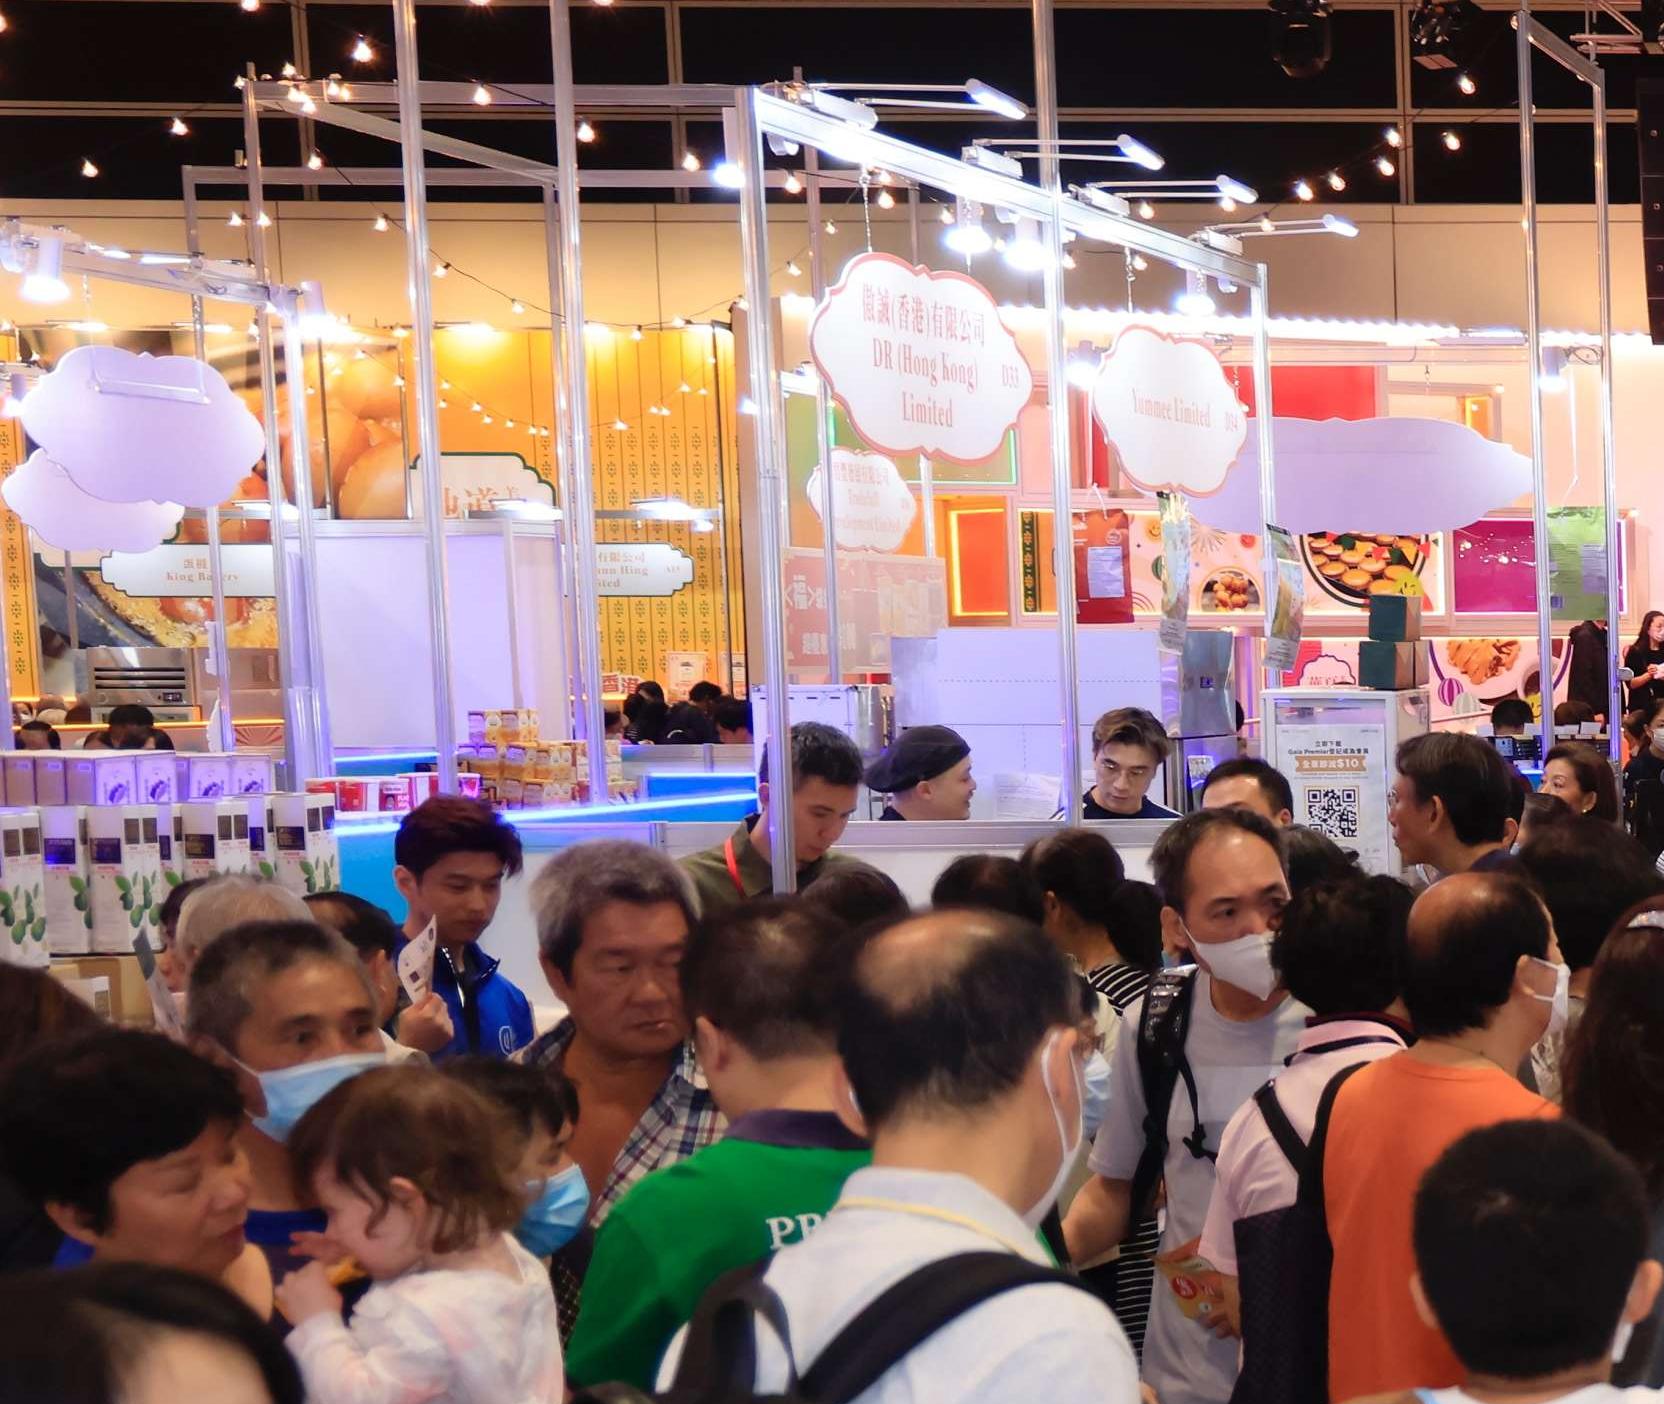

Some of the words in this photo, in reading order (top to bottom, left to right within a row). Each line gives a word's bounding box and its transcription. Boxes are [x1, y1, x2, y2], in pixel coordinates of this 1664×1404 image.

[872, 337, 894, 371] DR
[897, 342, 939, 387] (Hong
[941, 350, 979, 394] Kong)
[901, 390, 954, 428] Limited
[1174, 396, 1211, 428] Limited
[198, 572, 239, 583] Baery
